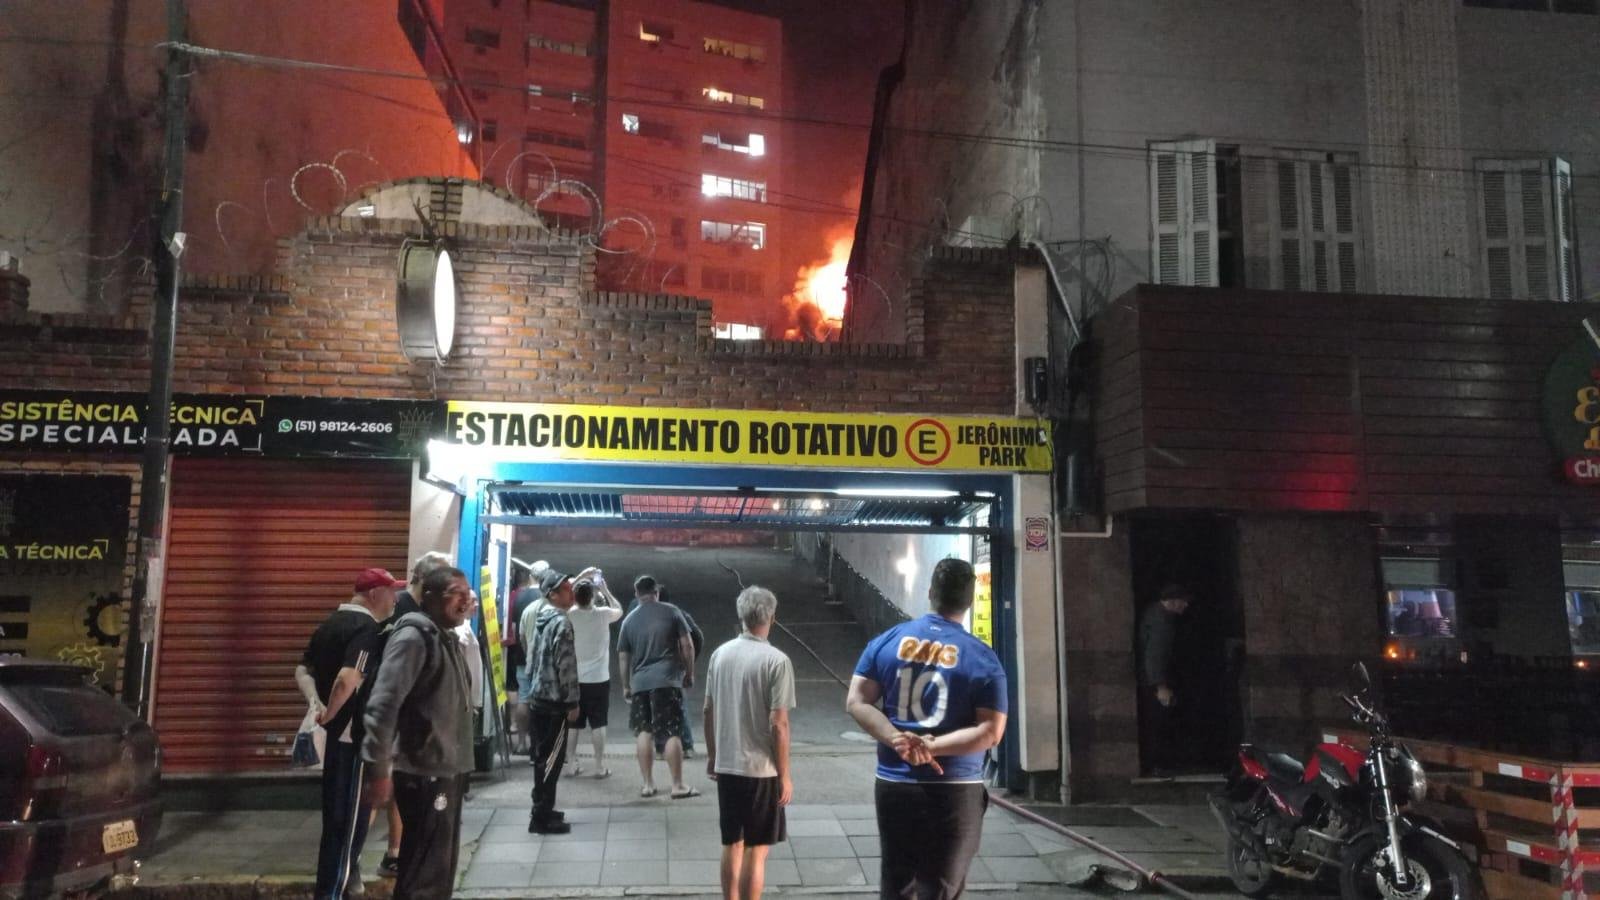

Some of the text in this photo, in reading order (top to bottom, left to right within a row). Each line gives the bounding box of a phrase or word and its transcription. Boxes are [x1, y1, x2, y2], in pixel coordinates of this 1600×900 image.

[0, 399, 257, 425] SISTÊNCIA ÉCNICA
[0, 423, 239, 447] SPECIALIADA
[295, 420, 393, 433] (51) 98124-2606
[447, 411, 937, 458] ESTACIONAMENTO ROTATIVO E
[956, 422, 1048, 448] JERÔNIMO
[979, 446, 1027, 467] PARK
[14, 541, 104, 561] TÉCNICA
[896, 667, 948, 729] 10
